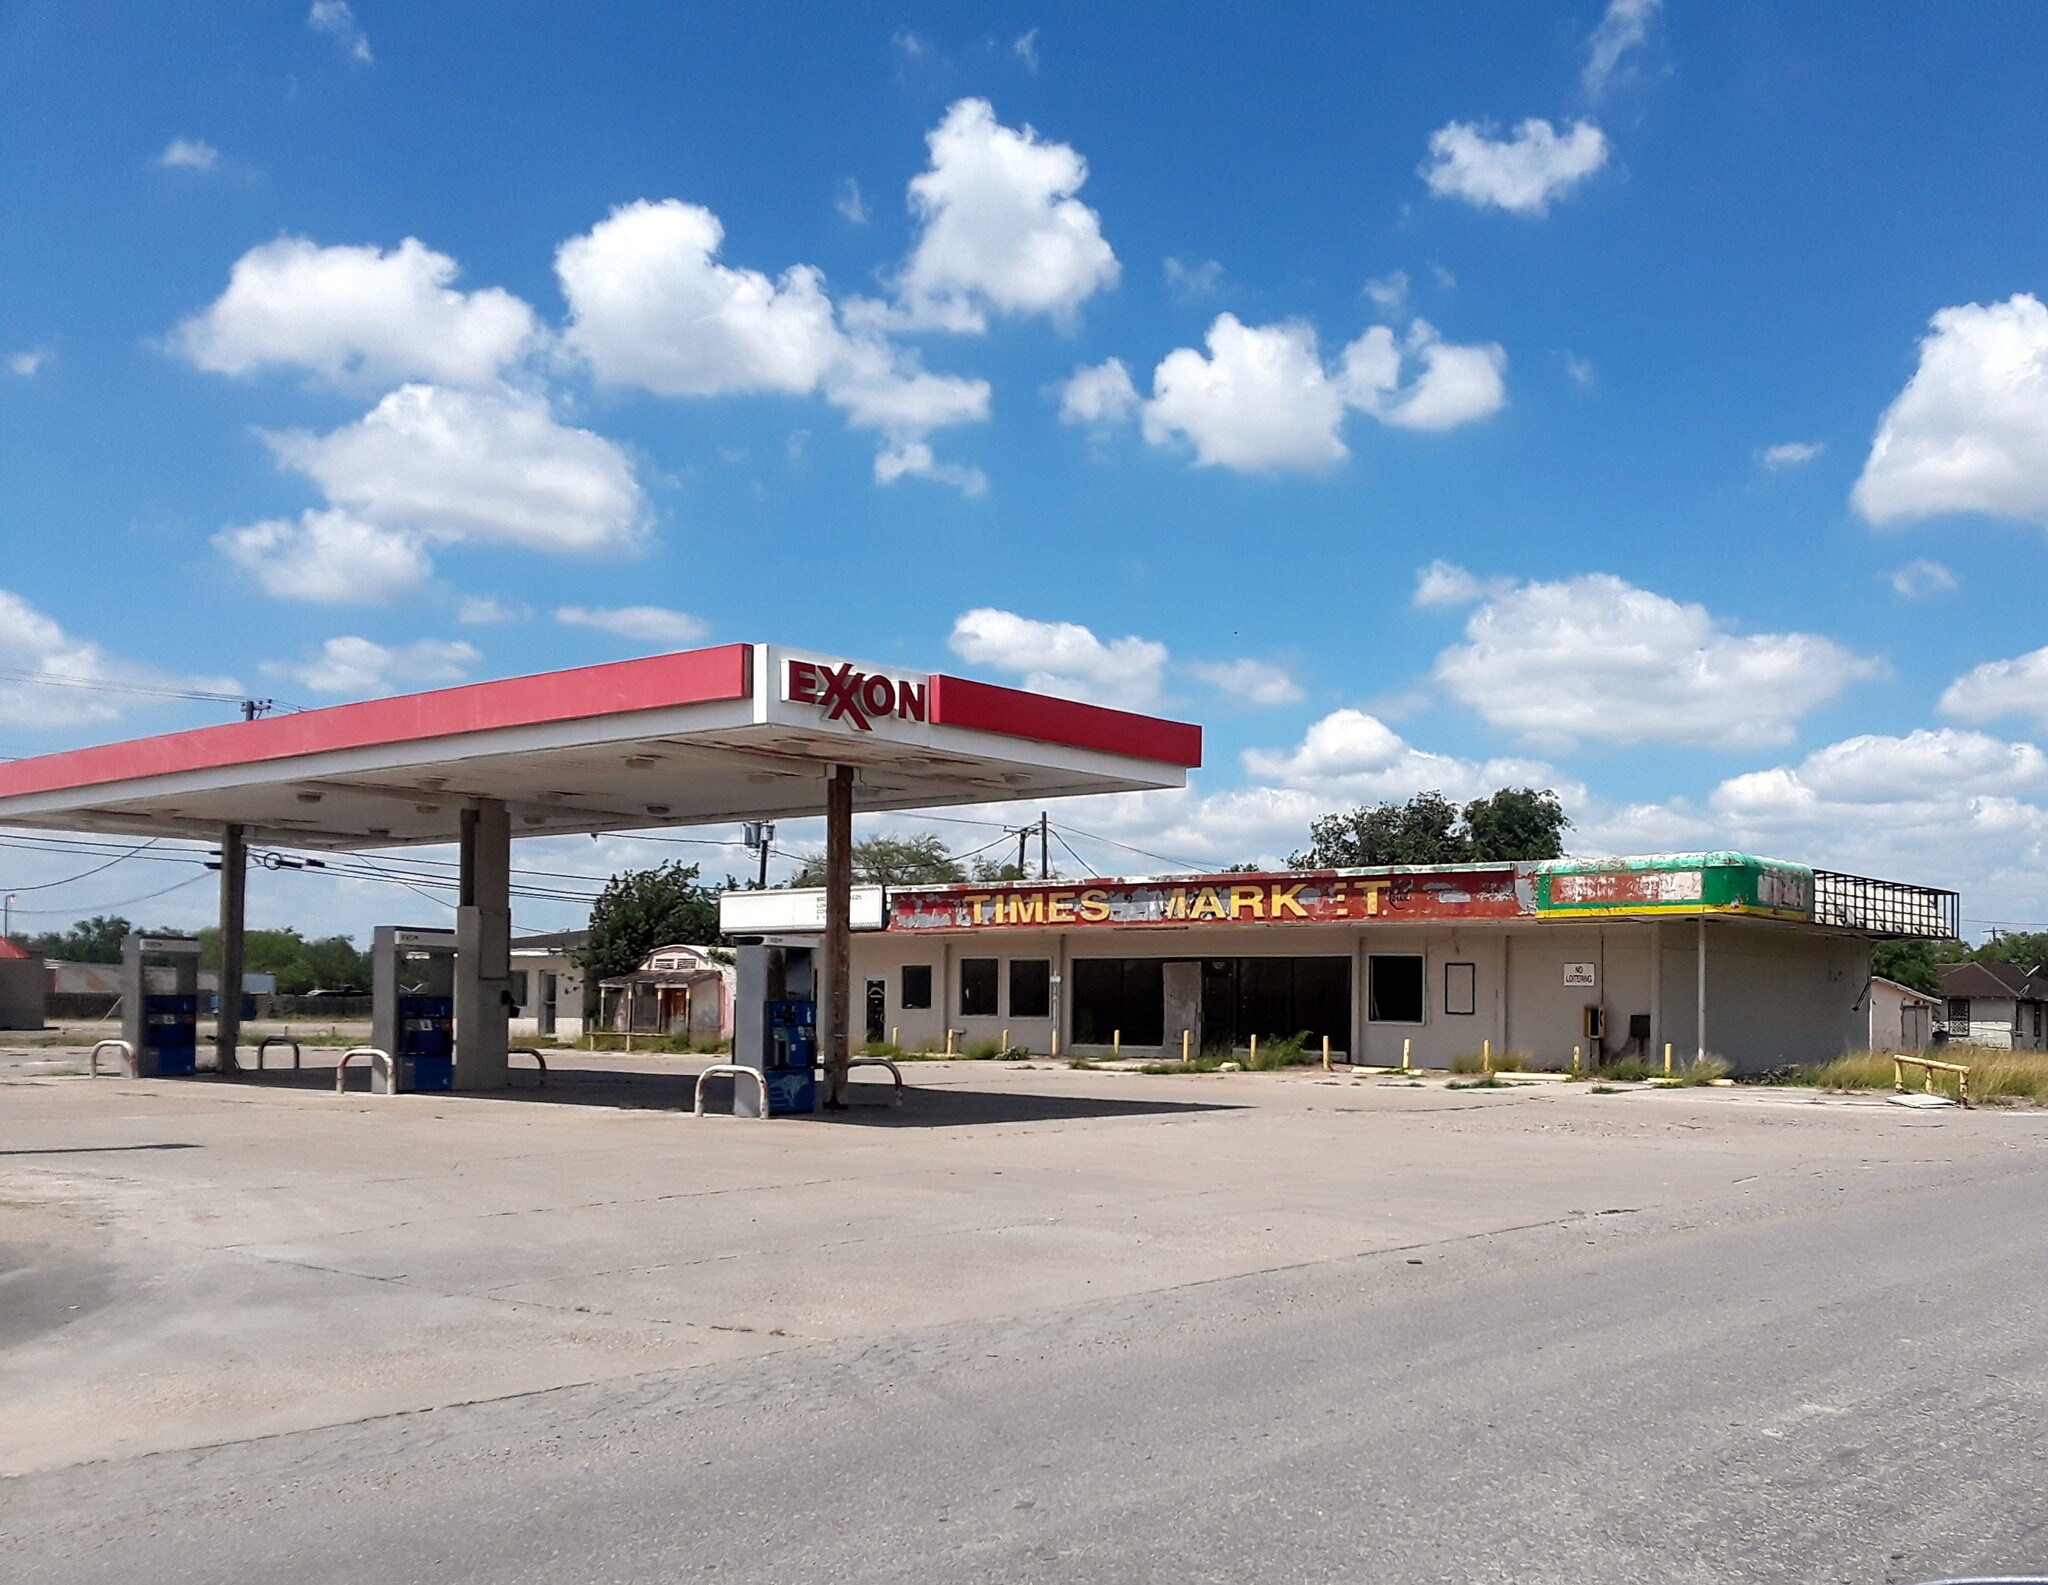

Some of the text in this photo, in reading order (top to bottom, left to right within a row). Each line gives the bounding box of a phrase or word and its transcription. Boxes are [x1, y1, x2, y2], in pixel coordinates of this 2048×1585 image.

[786, 660, 926, 731] EXXON
[964, 888, 1110, 925] TIMES
[1565, 974, 1593, 983] LOITERING
[1574, 965, 1584, 974] NO
